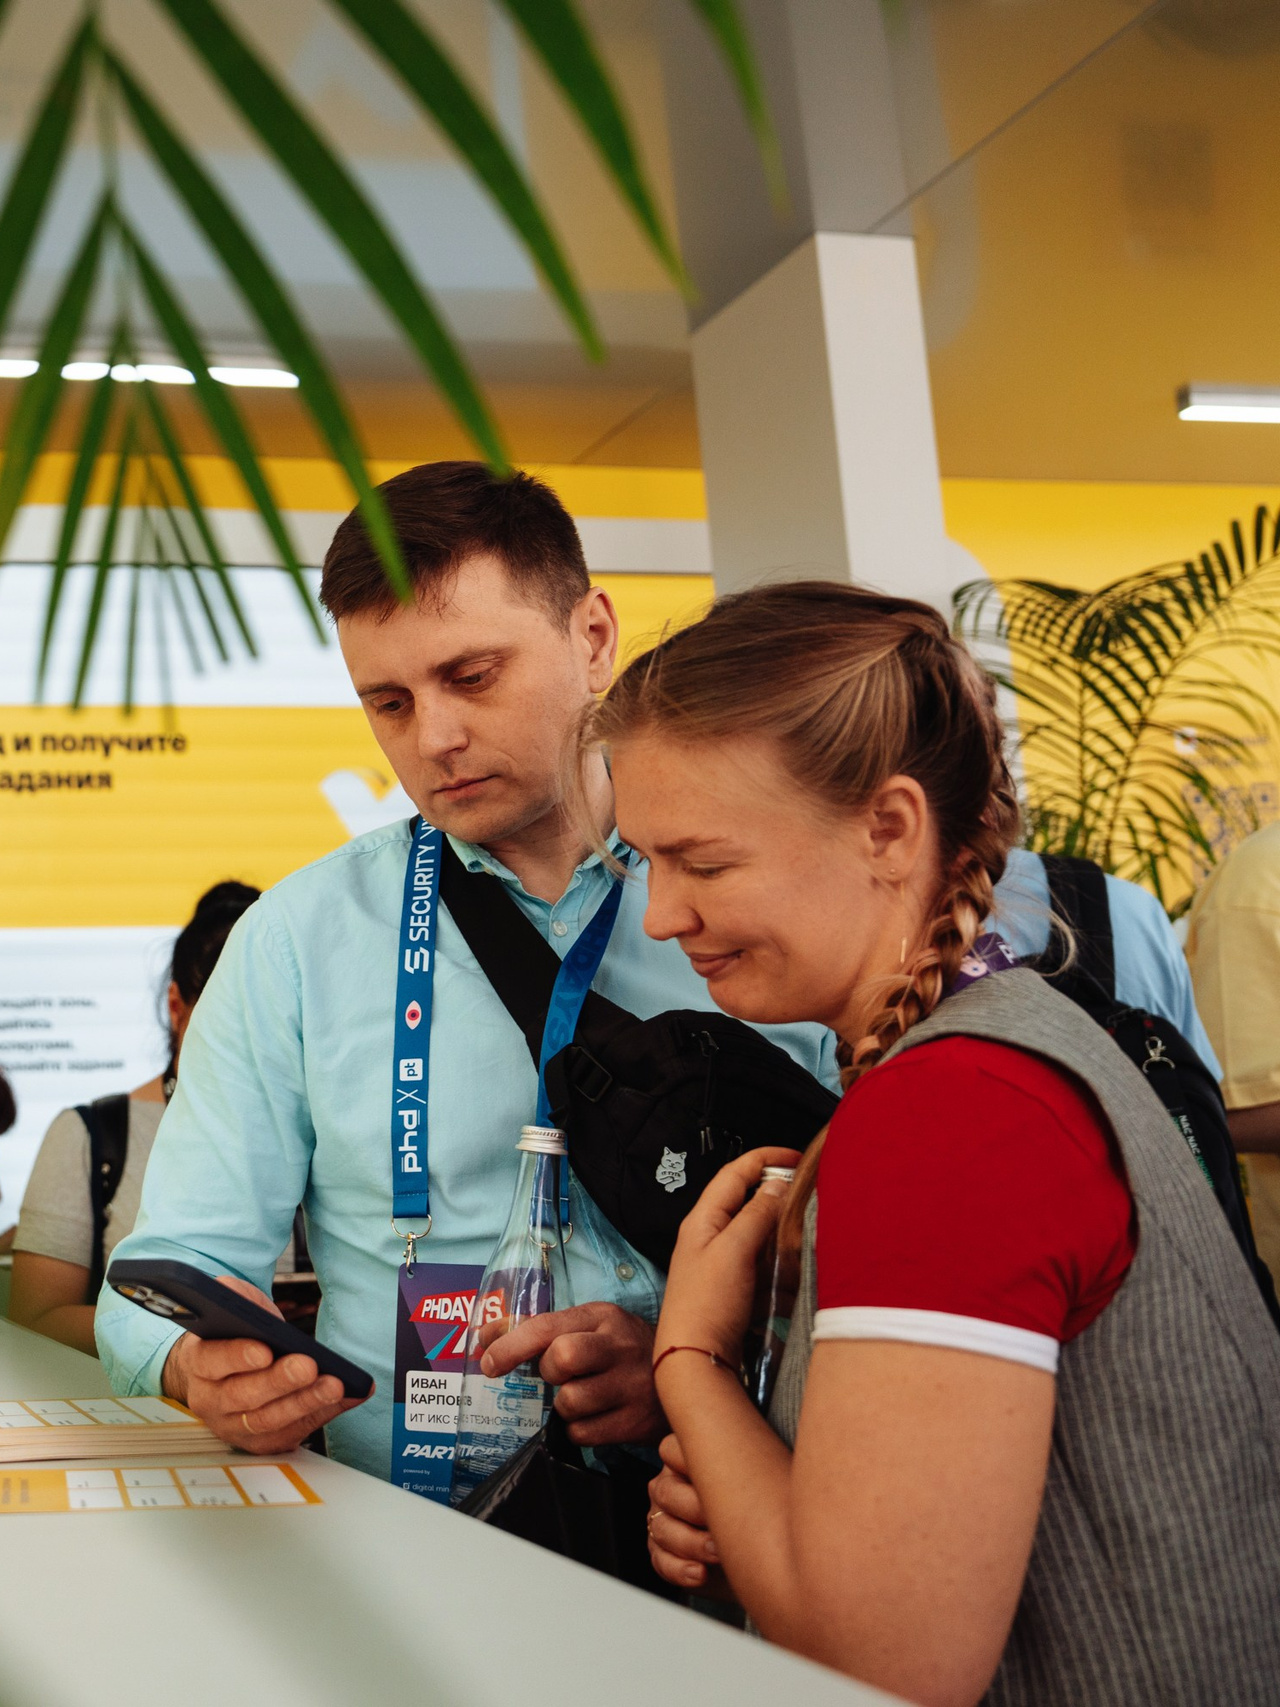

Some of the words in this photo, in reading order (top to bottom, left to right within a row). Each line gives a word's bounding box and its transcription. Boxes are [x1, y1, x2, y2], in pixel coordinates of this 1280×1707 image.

[13, 733, 32, 753] и
[40, 732, 188, 759] получите
[408, 844, 436, 942] SECURITY
[411, 1377, 447, 1390] ИВАН
[410, 1413, 425, 1424] ИТ
[427, 1414, 451, 1424] ИКС
[412, 1483, 435, 1493] digital
